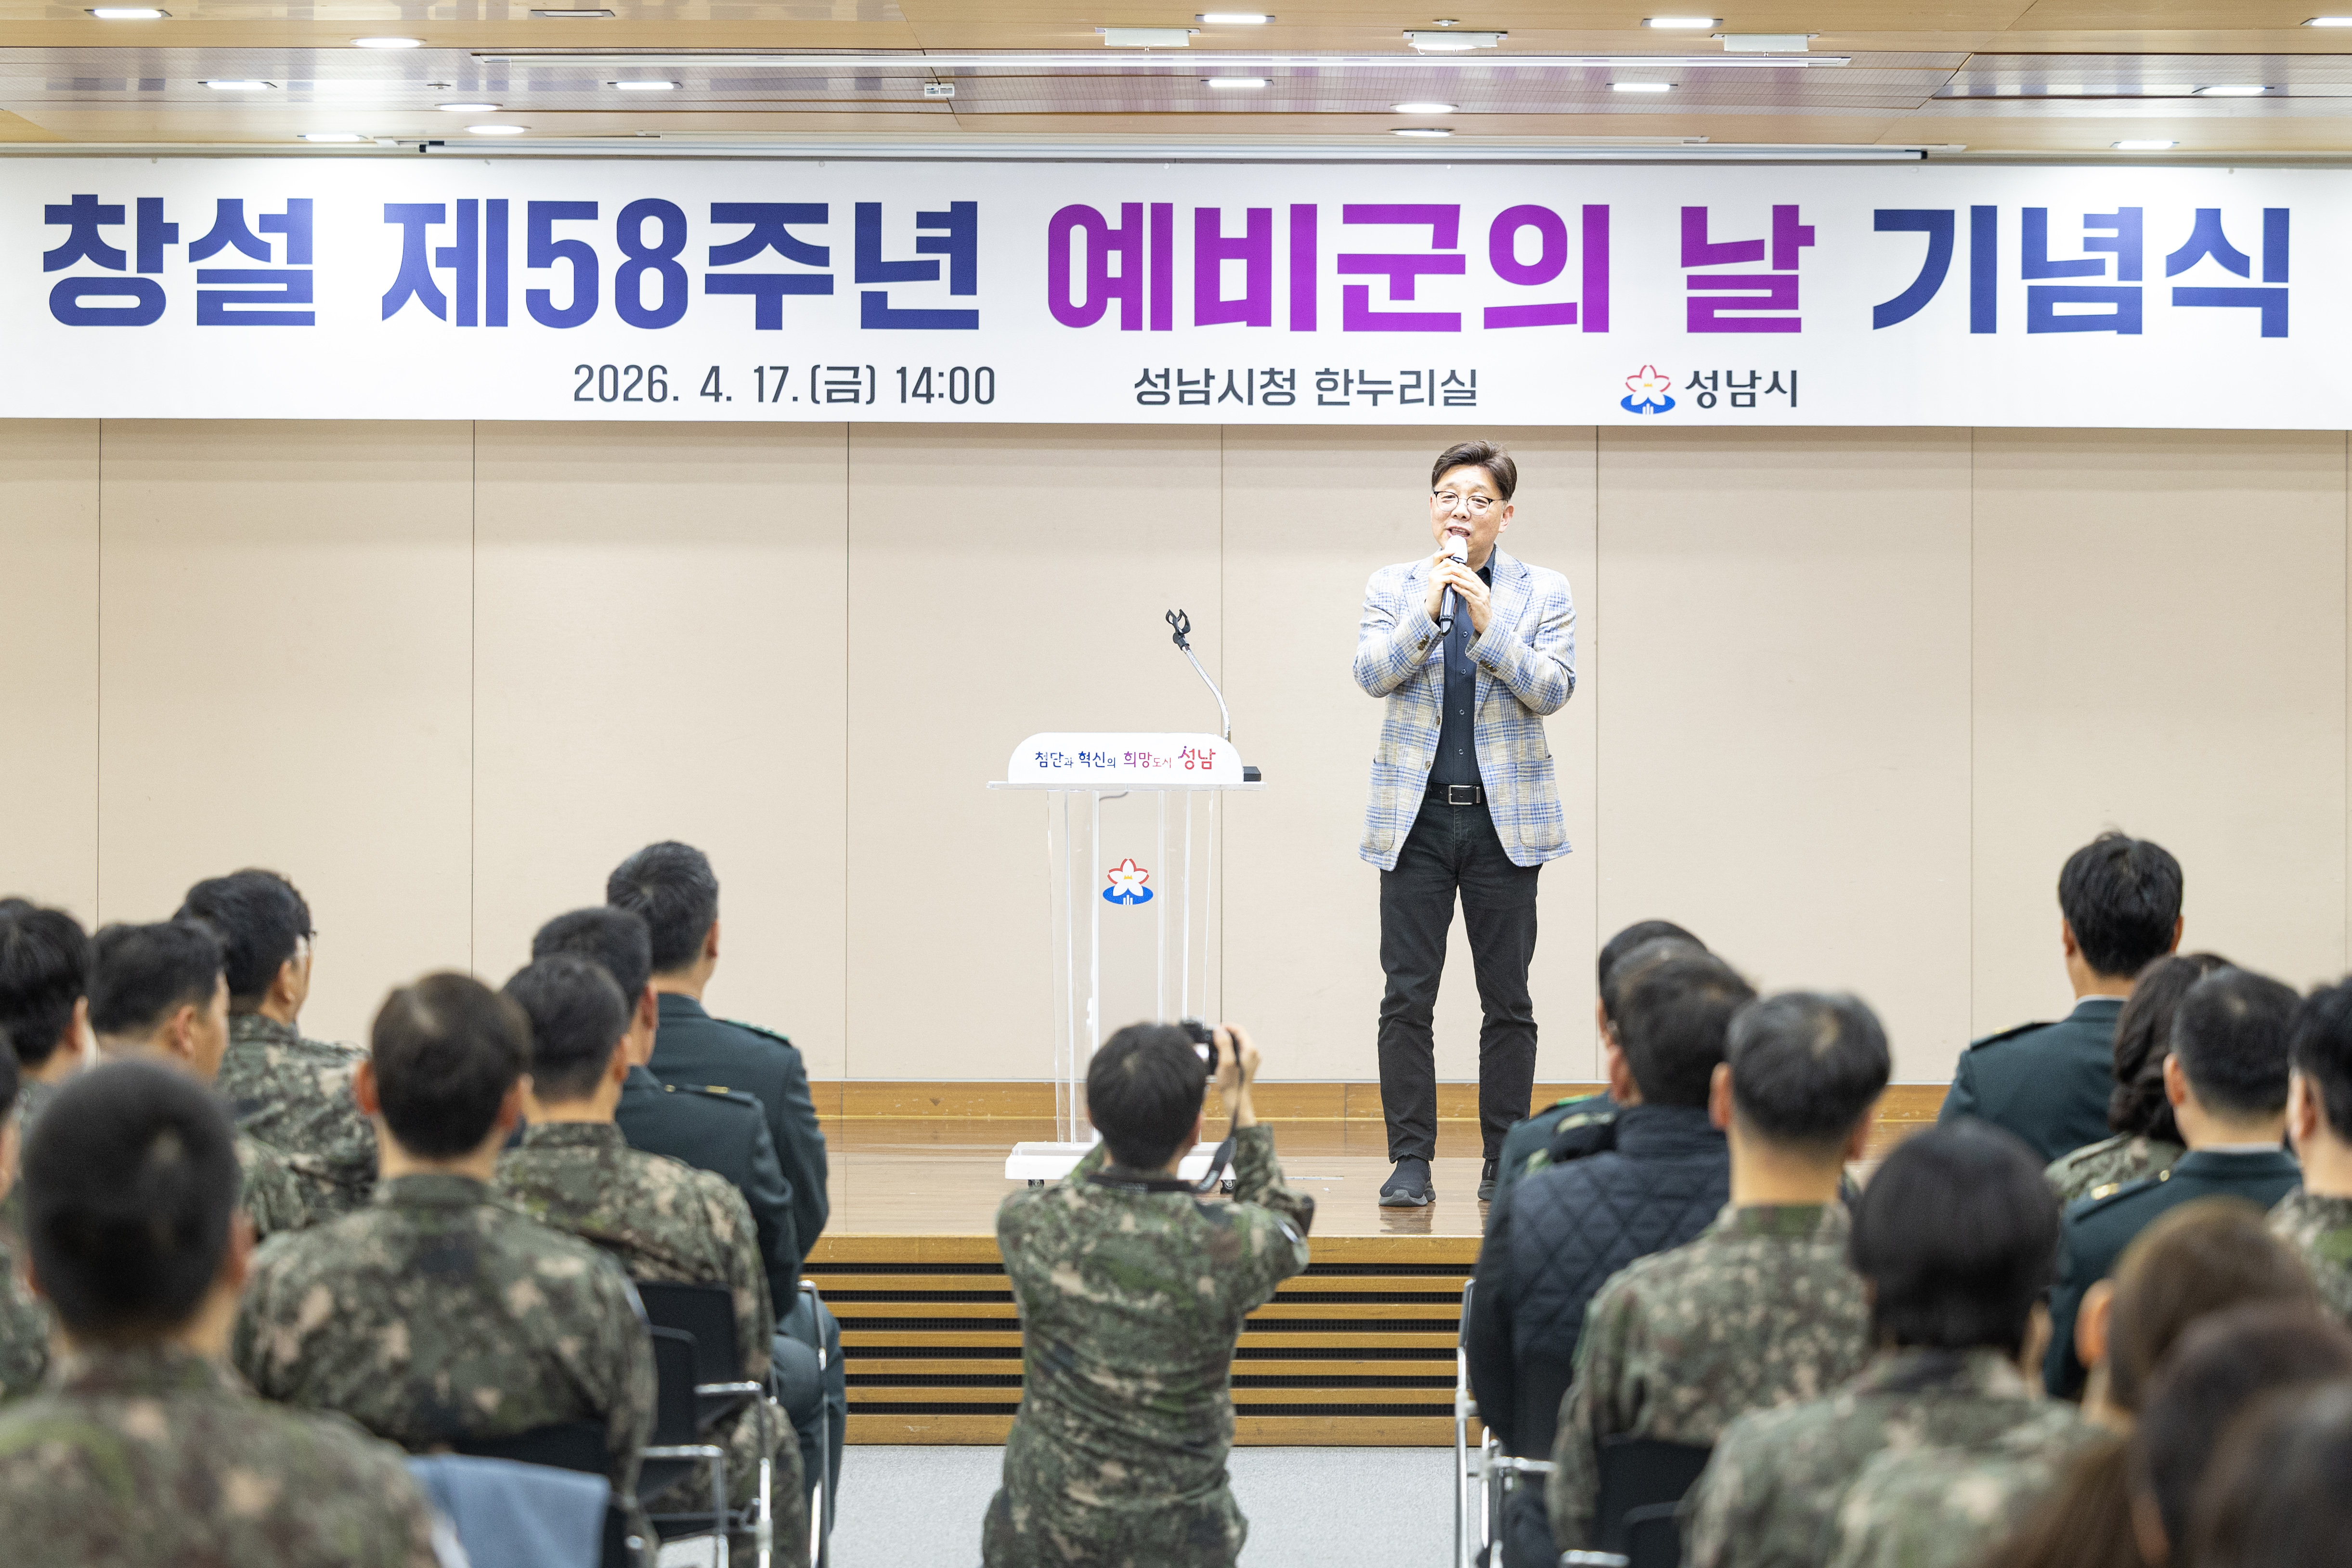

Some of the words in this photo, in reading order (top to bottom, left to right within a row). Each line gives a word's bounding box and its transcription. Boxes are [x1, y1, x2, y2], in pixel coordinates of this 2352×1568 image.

[43, 194, 315, 327] 창설
[382, 198, 979, 330] 제58주년
[1048, 202, 1610, 333] 예비군의
[1681, 204, 1815, 333] 날
[1872, 205, 2290, 338] 기념식
[574, 364, 678, 403] 2026.
[700, 365, 732, 402] 4.
[896, 366, 995, 405] 14:00
[1134, 367, 1296, 406] 성남시청
[1315, 368, 1477, 406] 한누리실
[1685, 370, 1797, 409] 성남시
[1035, 751, 1074, 768] 첨단과
[1078, 751, 1116, 768] 혁신의
[1123, 751, 1171, 768] 희망도시
[1178, 746, 1216, 770] 성남
